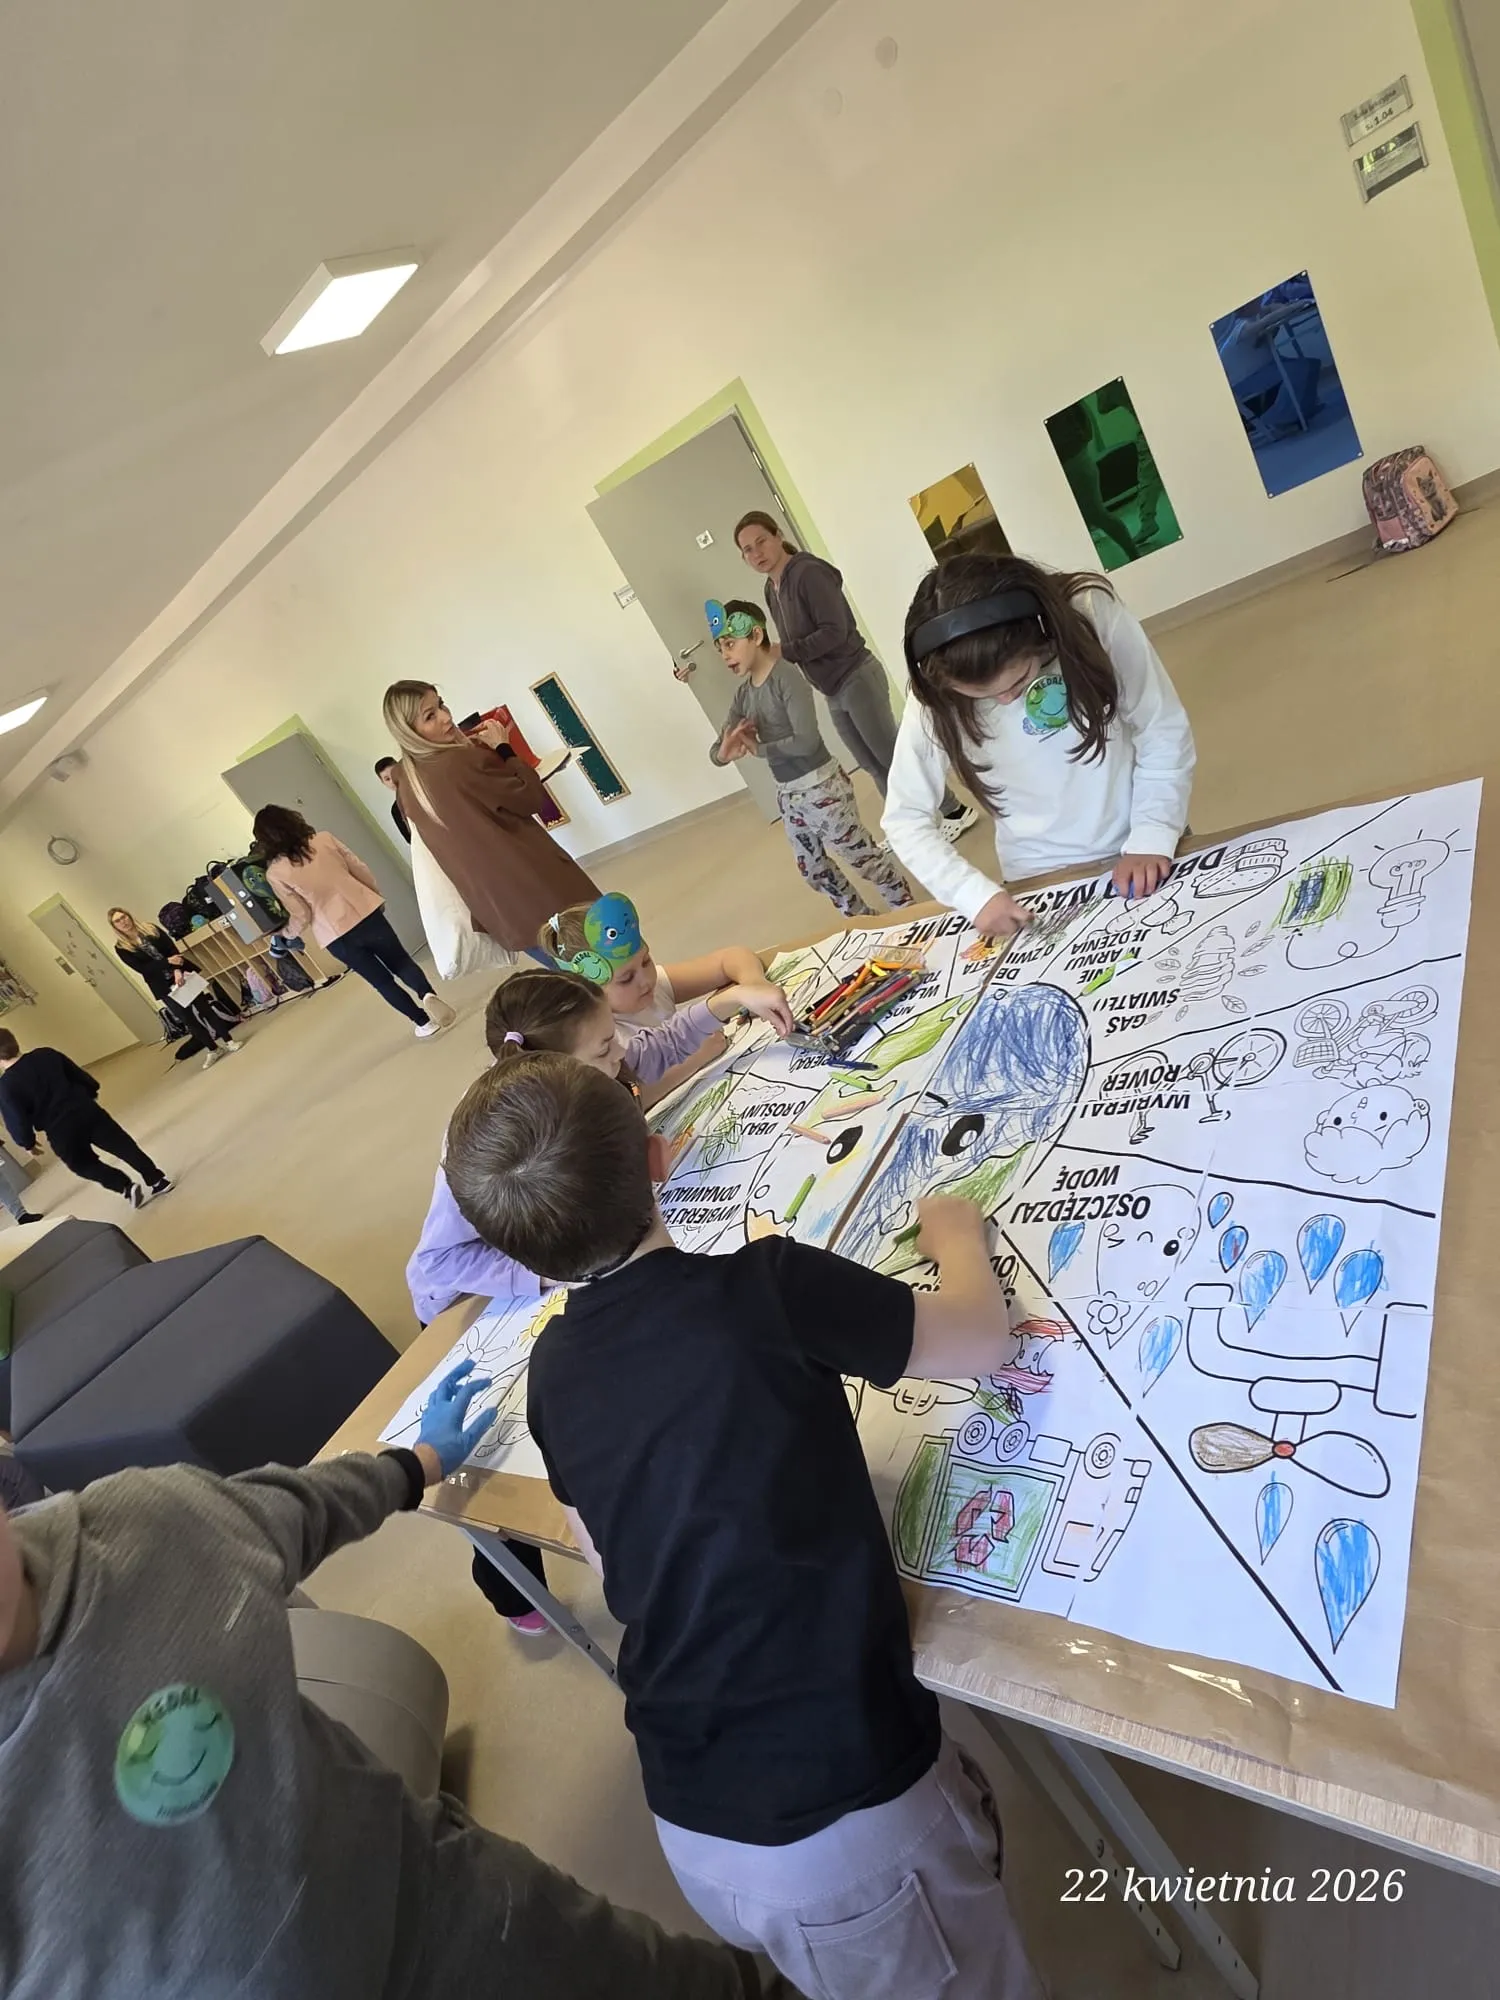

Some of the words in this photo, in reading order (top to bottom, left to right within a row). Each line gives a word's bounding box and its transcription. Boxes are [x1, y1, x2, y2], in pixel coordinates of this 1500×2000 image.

[1015, 879, 1099, 914] NASZ
[898, 915, 976, 947] IEMIĘ
[1070, 928, 1152, 956] JEDZENIA
[1104, 1013, 1147, 1038] GAŚ
[1102, 1064, 1181, 1092] ROWER
[737, 1102, 795, 1121] ROŚLINY
[740, 1121, 778, 1136] DBAJ
[1052, 1165, 1121, 1192] WODĘ
[671, 1203, 741, 1225] WYBIERAJ
[1010, 1192, 1152, 1224] OSZCZĘDZAJ
